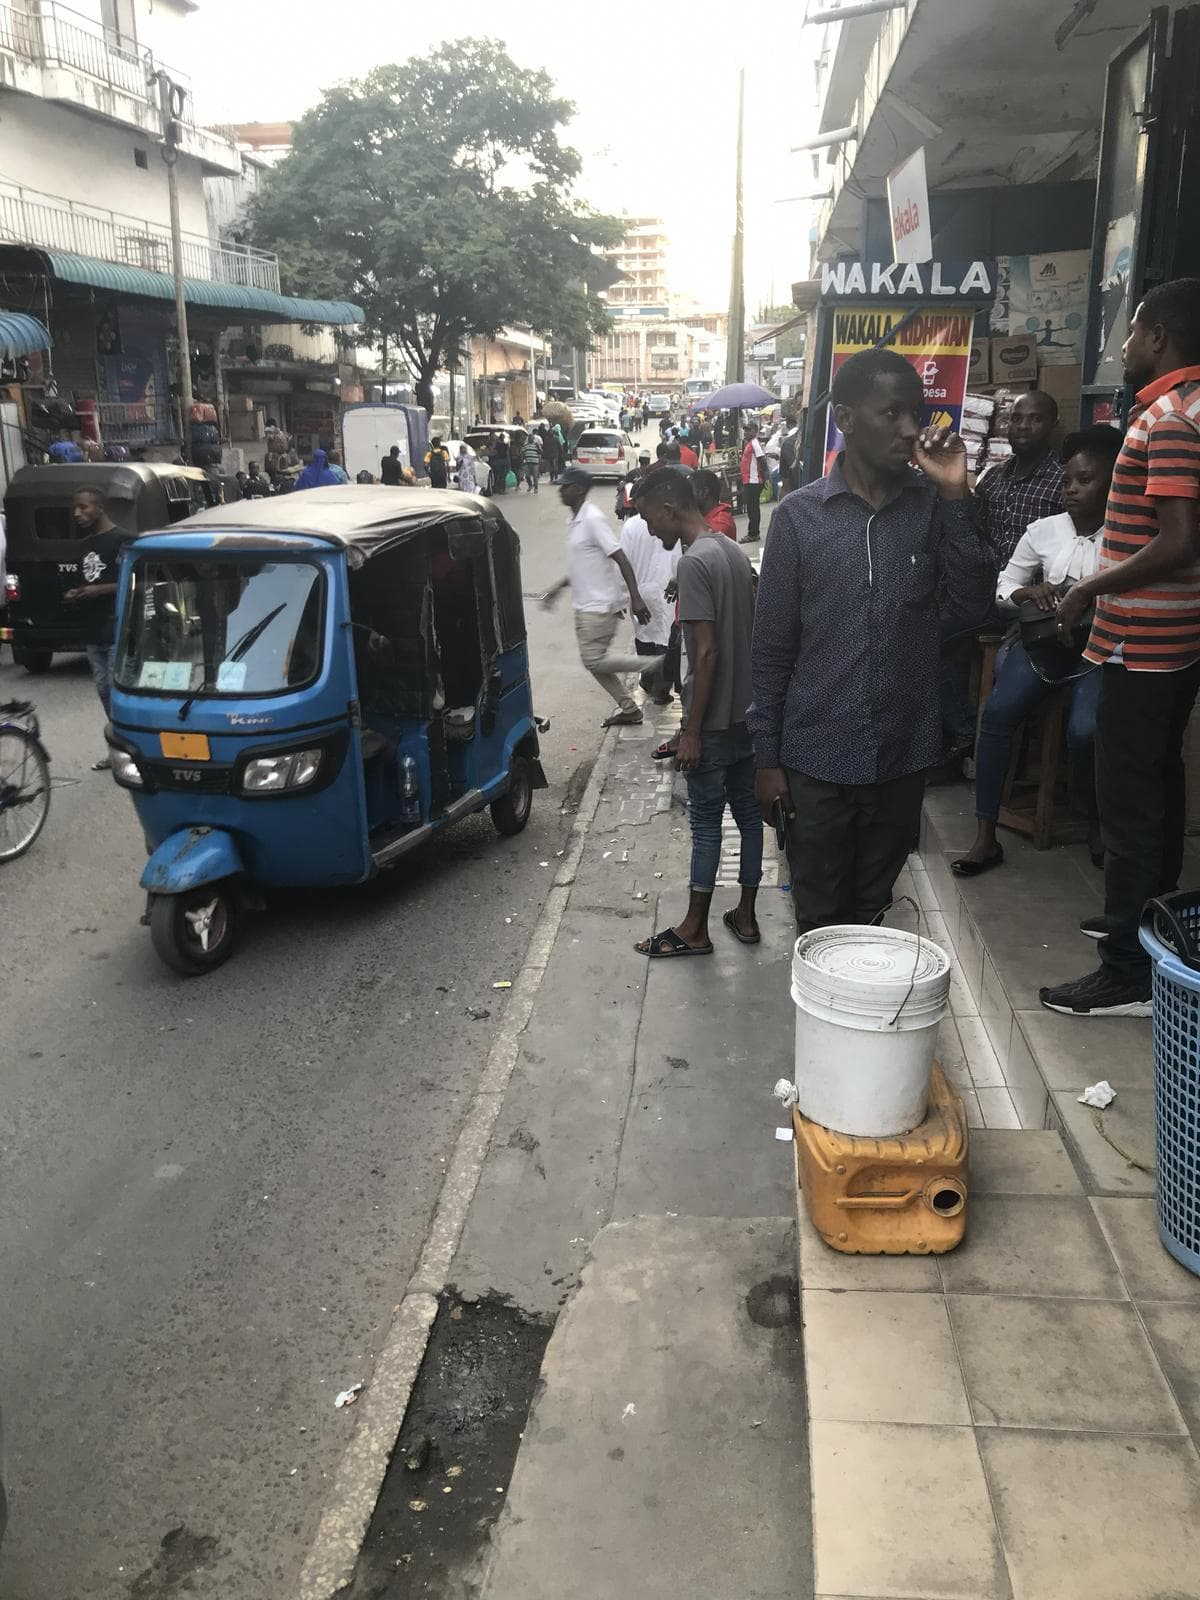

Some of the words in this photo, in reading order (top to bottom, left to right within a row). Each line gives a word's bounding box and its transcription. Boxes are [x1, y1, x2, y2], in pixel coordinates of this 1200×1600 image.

[821, 261, 991, 295] WAKALA
[836, 314, 896, 346] WAKALA
[58, 563, 79, 572] TVS
[172, 768, 202, 782] TVS
